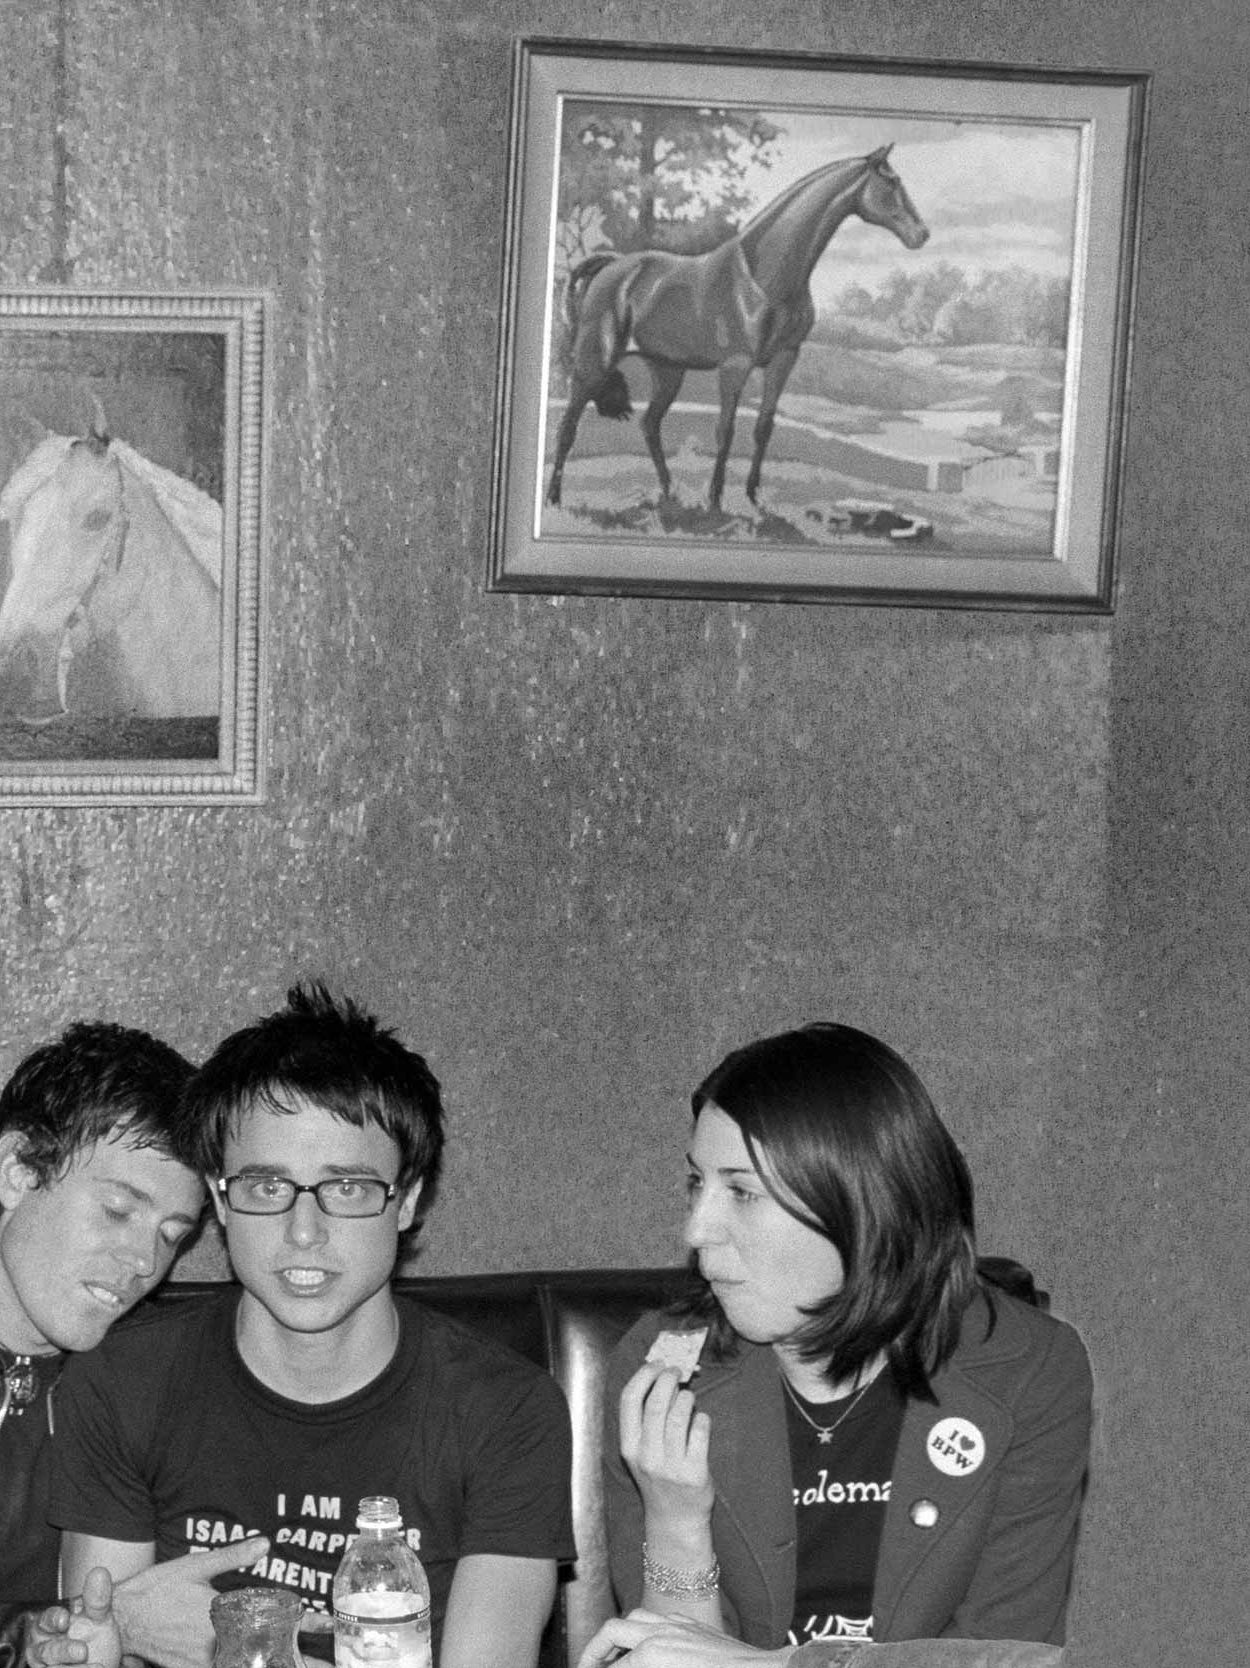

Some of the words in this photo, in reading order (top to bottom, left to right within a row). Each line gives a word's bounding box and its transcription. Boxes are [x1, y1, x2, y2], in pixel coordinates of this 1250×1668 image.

[277, 1493, 286, 1517] I
[301, 1494, 341, 1520] AM
[239, 1555, 333, 1595] ARENT
